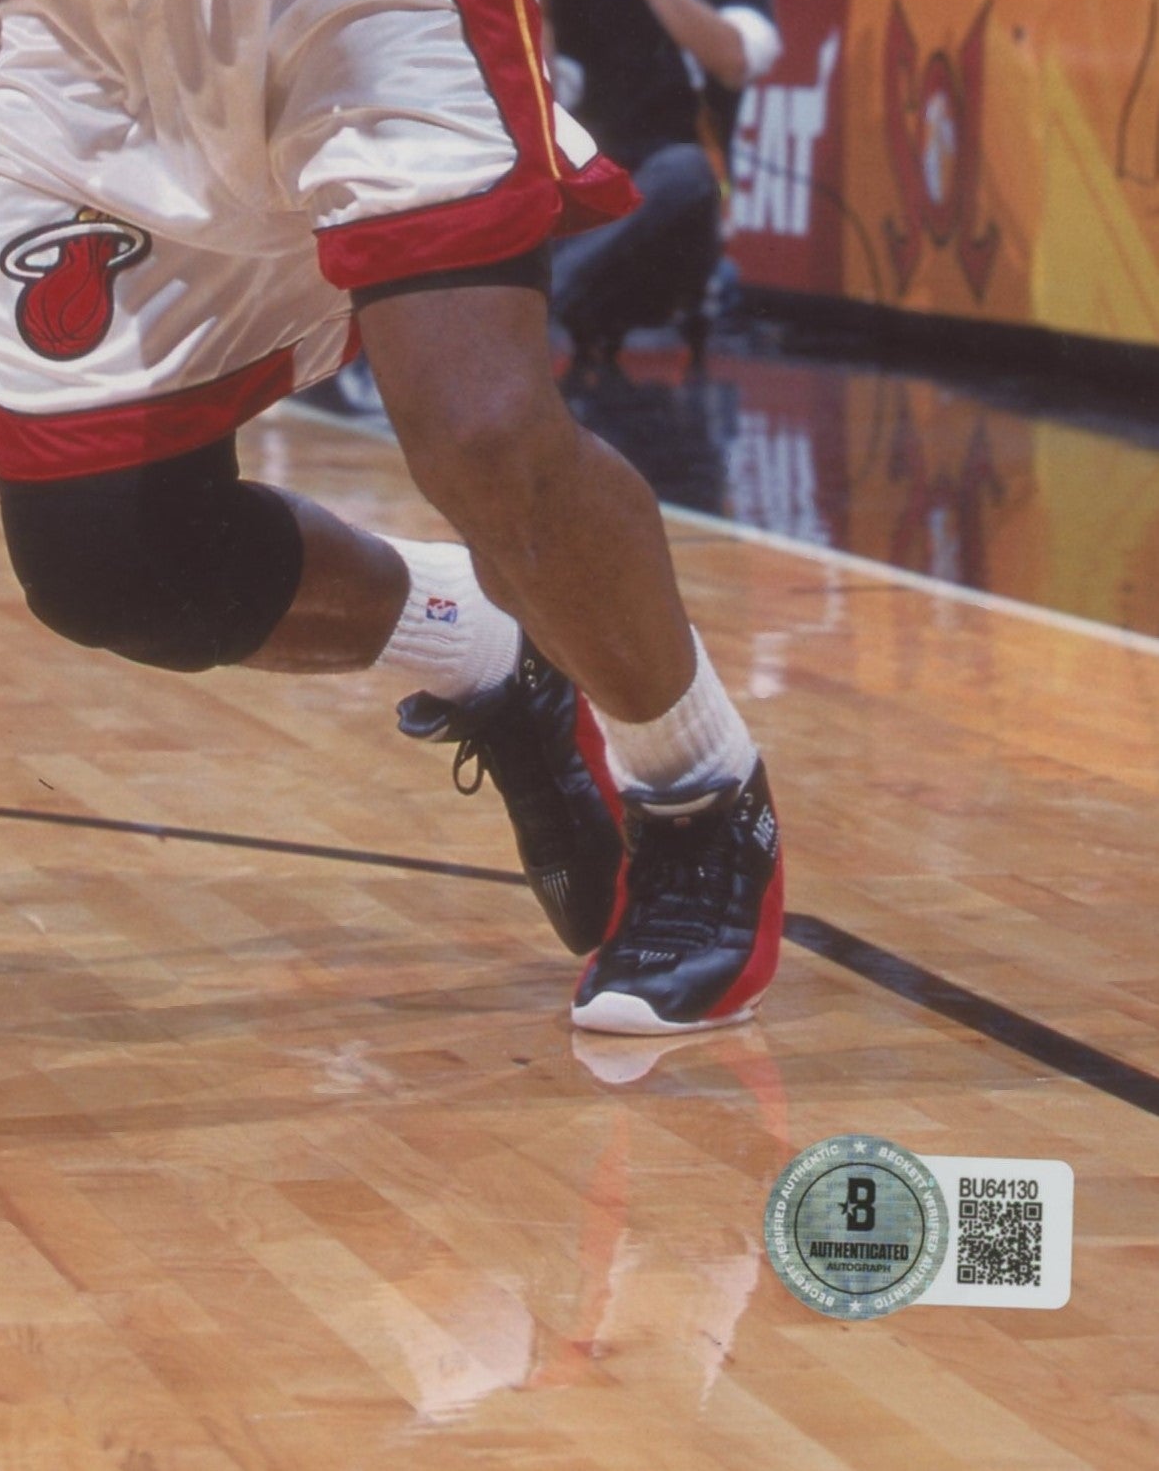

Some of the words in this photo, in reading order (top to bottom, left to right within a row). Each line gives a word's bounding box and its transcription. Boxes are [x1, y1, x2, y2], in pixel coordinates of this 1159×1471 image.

[728, 29, 840, 237] EAT
[780, 1144, 840, 1199] AUTHENTIC
[878, 1145, 929, 1189] BECKETT
[958, 1176, 1039, 1200] BU64130
[773, 1200, 789, 1263] VERIFIED
[922, 1189, 940, 1253] VERIFIED
[808, 1240, 910, 1261] AUTHENTICATED
[826, 1261, 892, 1274] AUTOGRAPH
[785, 1263, 836, 1308] BECKETT
[873, 1254, 934, 1309] AUTHENTIC
